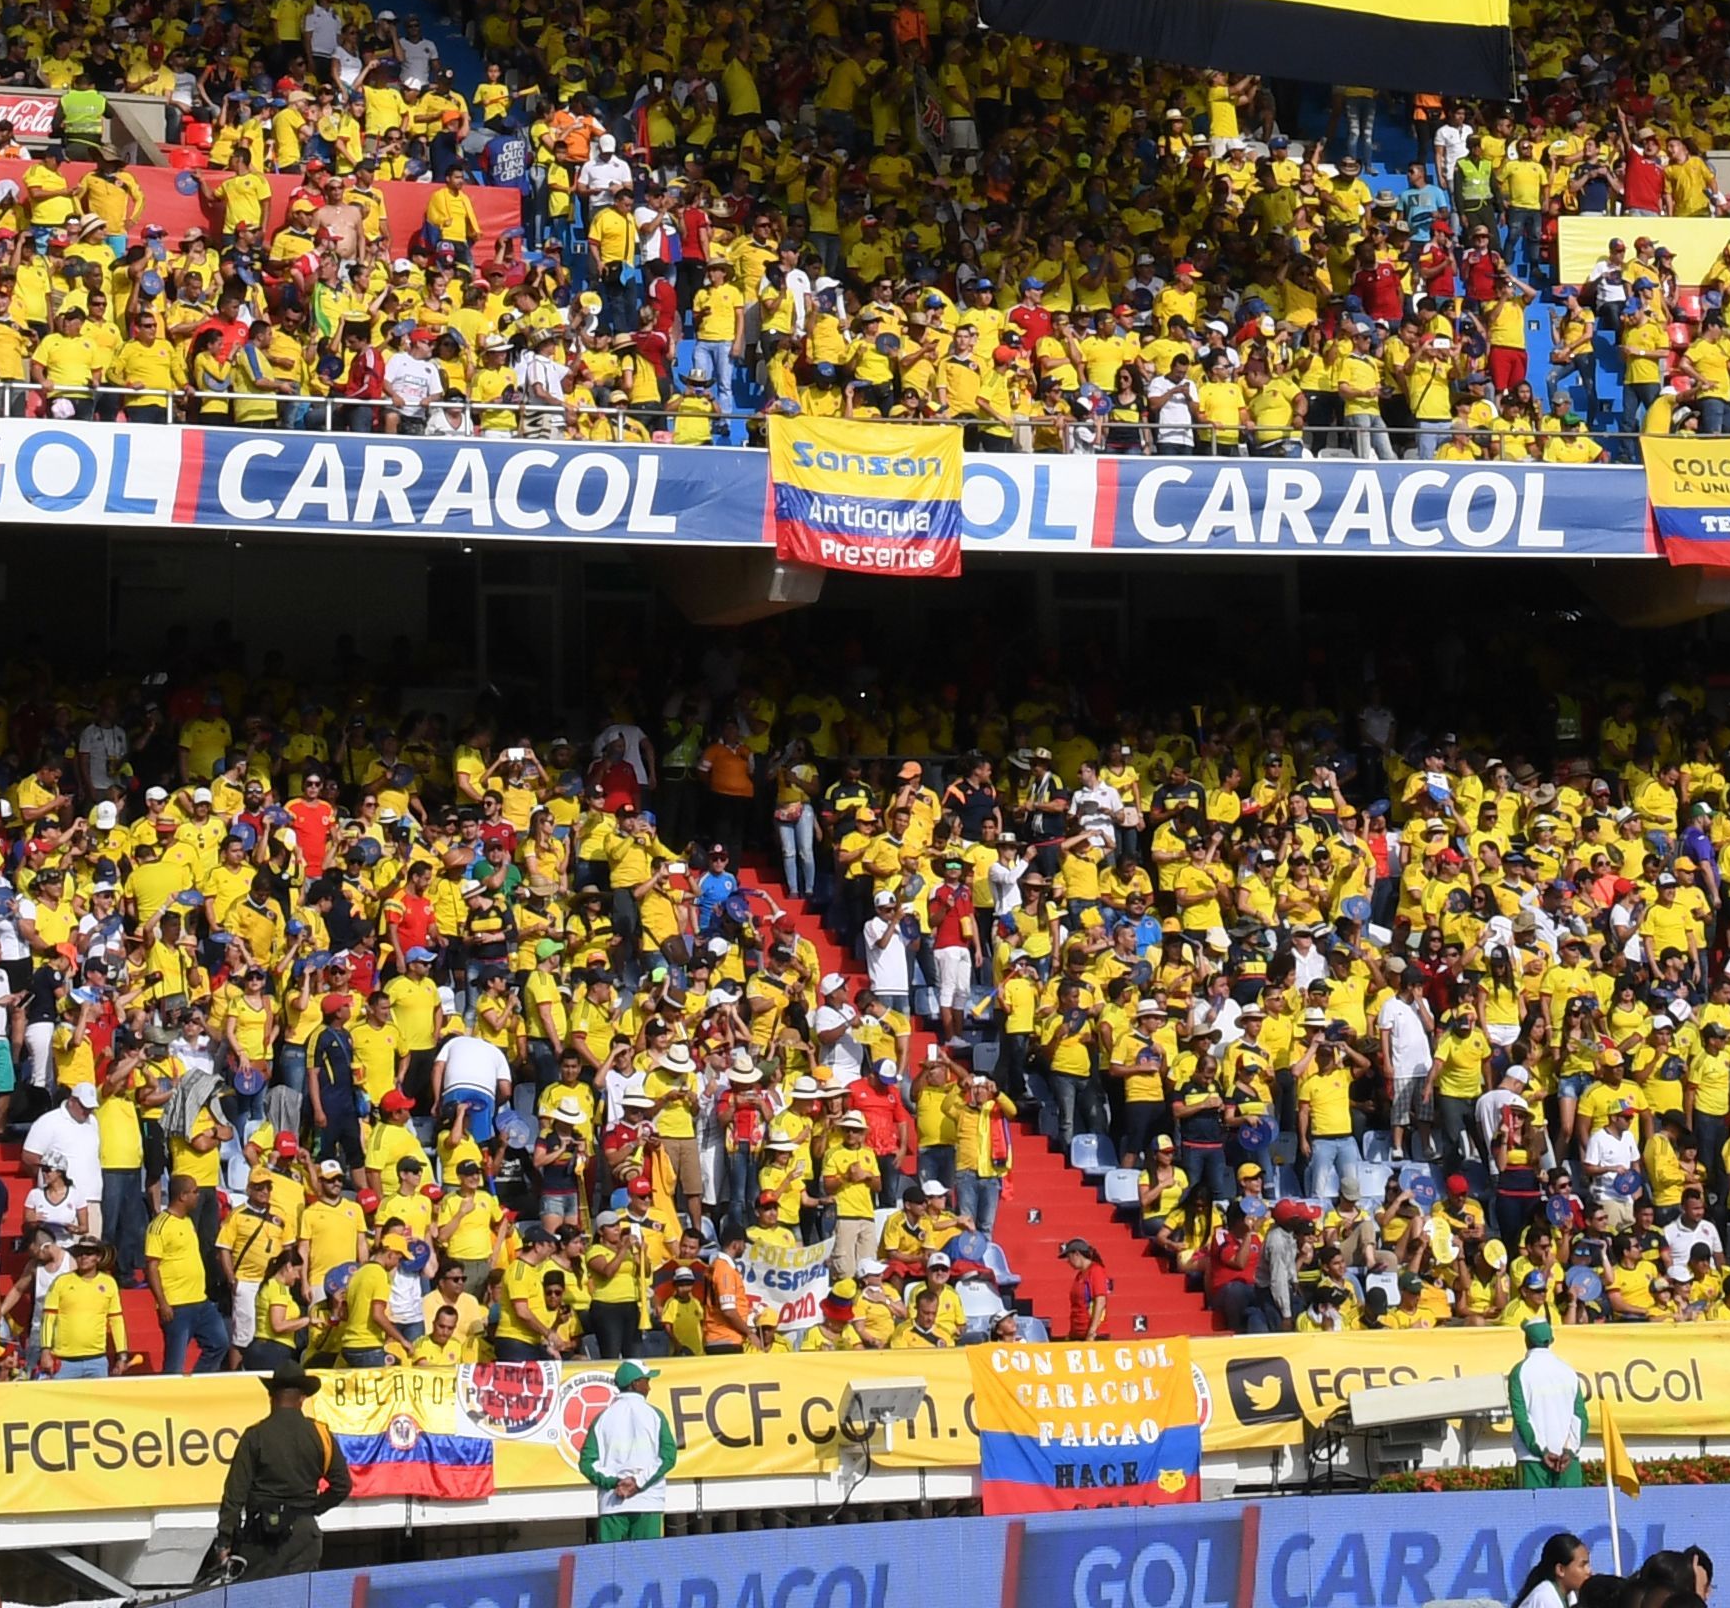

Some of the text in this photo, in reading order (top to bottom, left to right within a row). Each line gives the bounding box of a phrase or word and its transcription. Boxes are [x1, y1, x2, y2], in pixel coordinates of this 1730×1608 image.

[217, 437, 677, 534] CARACOL
[1674, 479, 1693, 493] LA
[961, 463, 1077, 542] OL
[1132, 468, 1566, 548] CARACOL
[820, 538, 936, 569] Presente
[991, 1343, 1174, 1375] CON EL GOL
[1016, 1376, 1160, 1409] CARACOL
[1038, 1418, 1160, 1448] FALCAO
[1055, 1461, 1139, 1490] HACE
[1072, 1538, 1228, 1608] GOL
